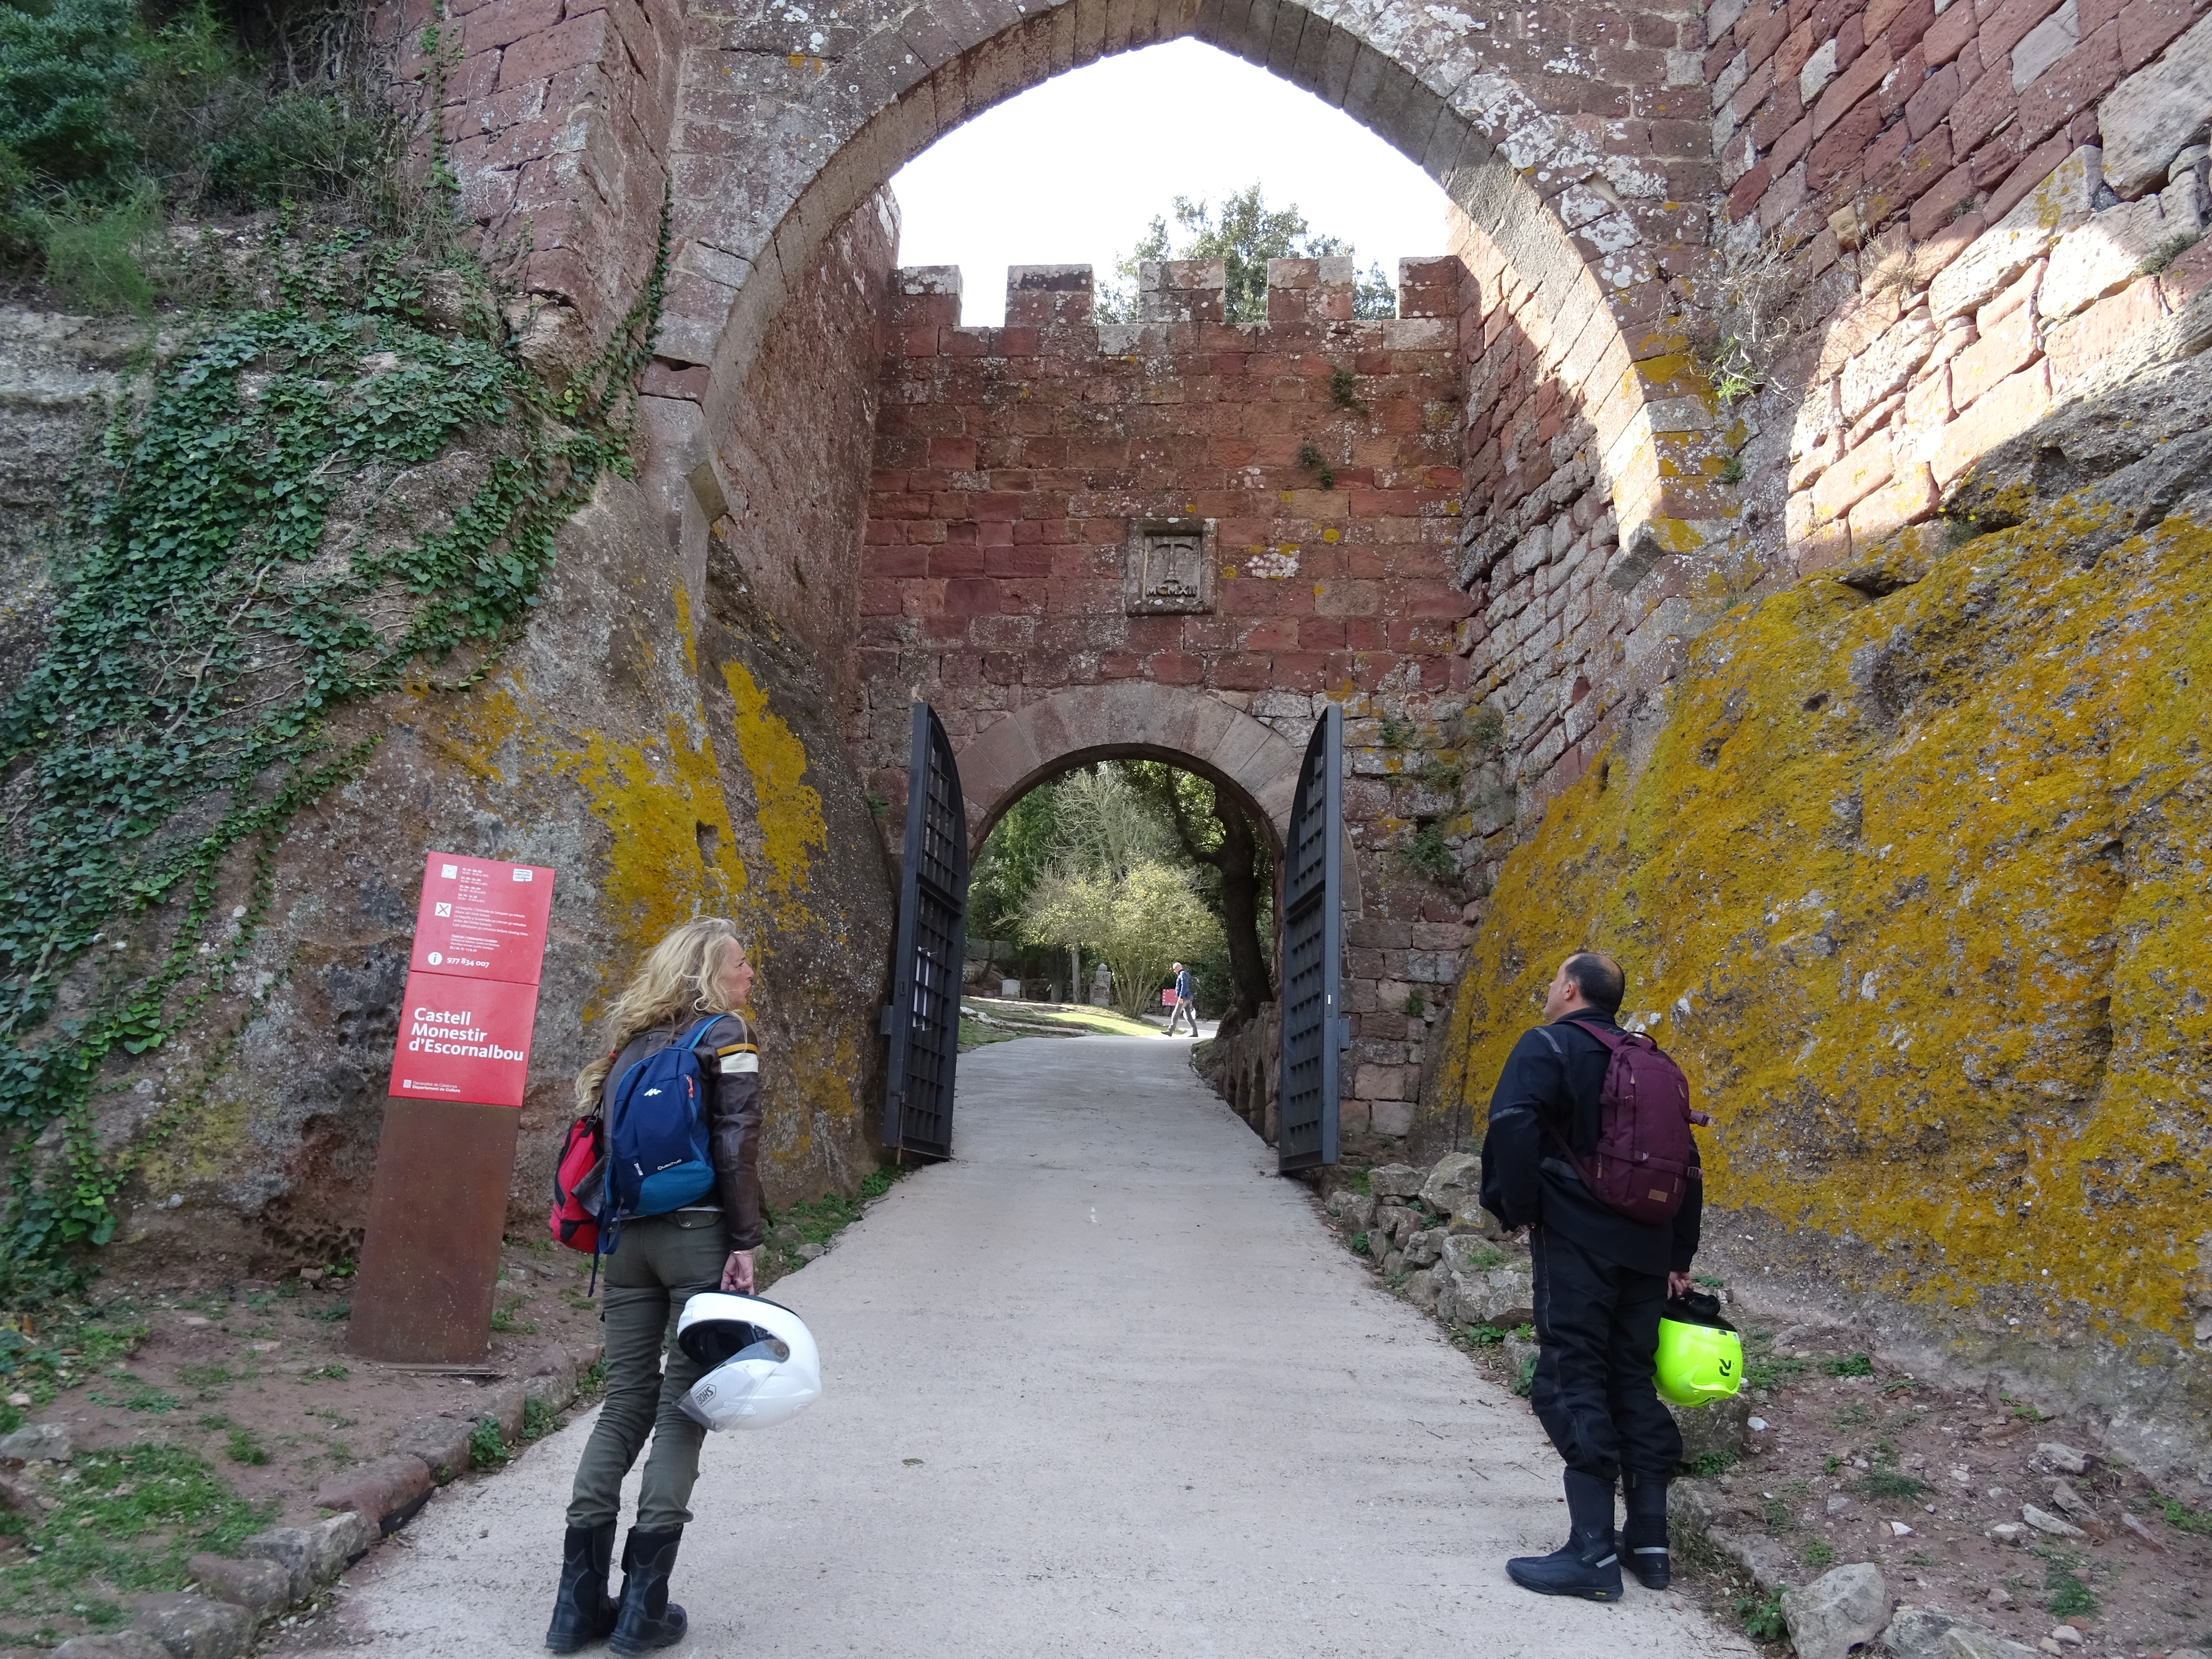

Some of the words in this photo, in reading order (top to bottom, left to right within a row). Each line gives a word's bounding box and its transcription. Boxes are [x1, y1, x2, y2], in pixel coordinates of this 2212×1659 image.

[461, 958, 474, 966] 834
[414, 1007, 471, 1025] Castell
[411, 1022, 487, 1042] Monestir
[409, 1037, 524, 1061] d'Escornalbou
